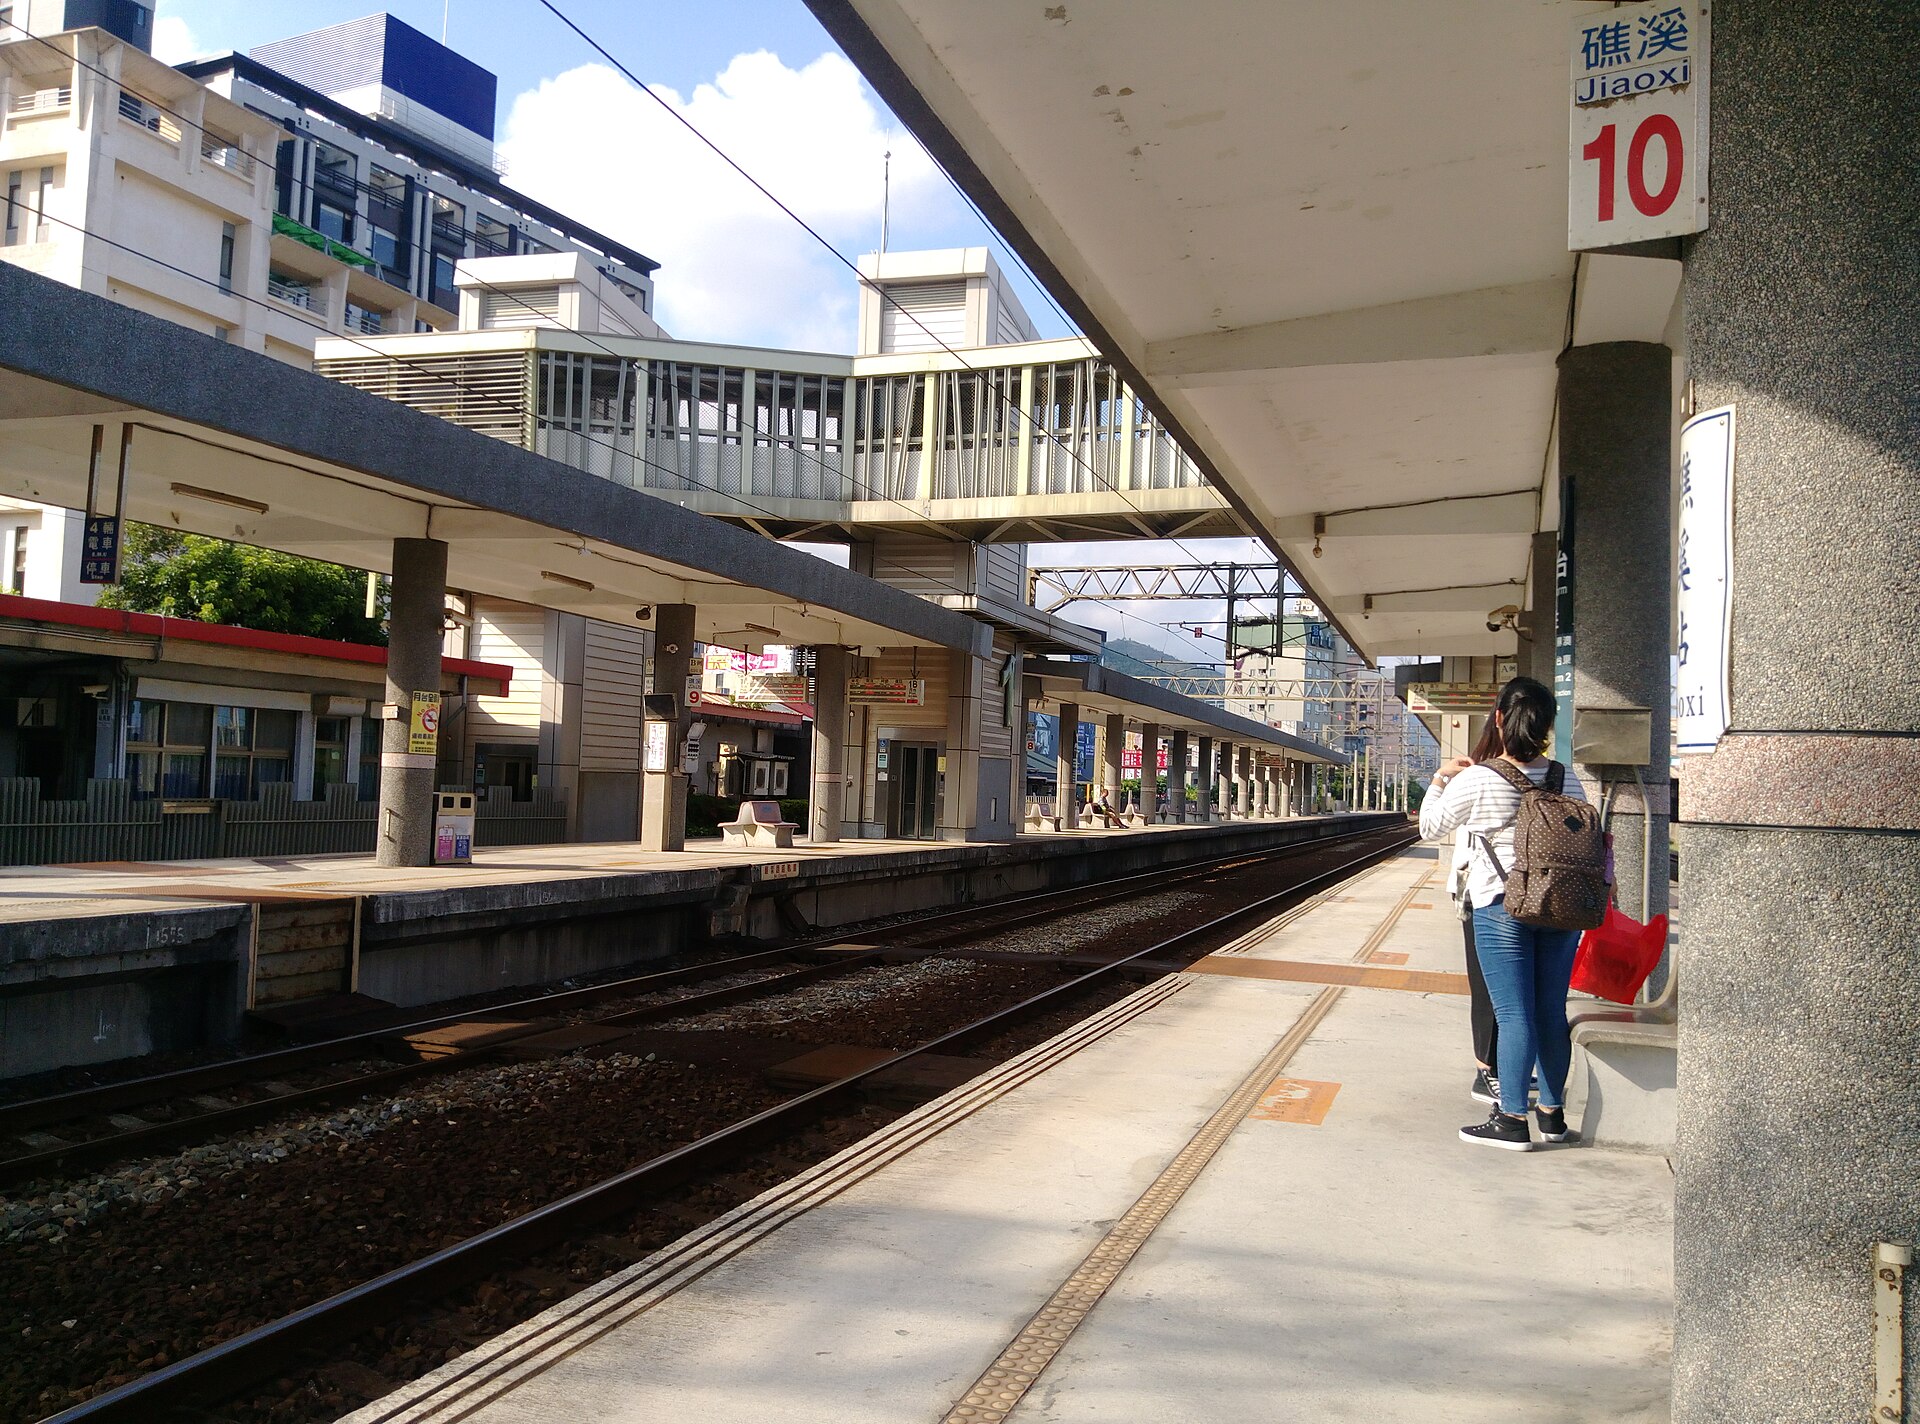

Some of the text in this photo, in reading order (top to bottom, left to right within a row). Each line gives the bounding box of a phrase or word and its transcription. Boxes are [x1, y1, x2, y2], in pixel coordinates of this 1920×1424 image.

[1581, 6, 1689, 71] 礁溪
[1577, 59, 1690, 103] Jiaoxi
[1583, 113, 1684, 222] 10
[689, 691, 700, 704] 9
[908, 680, 918, 689] 1B
[1413, 684, 1426, 694] 2A
